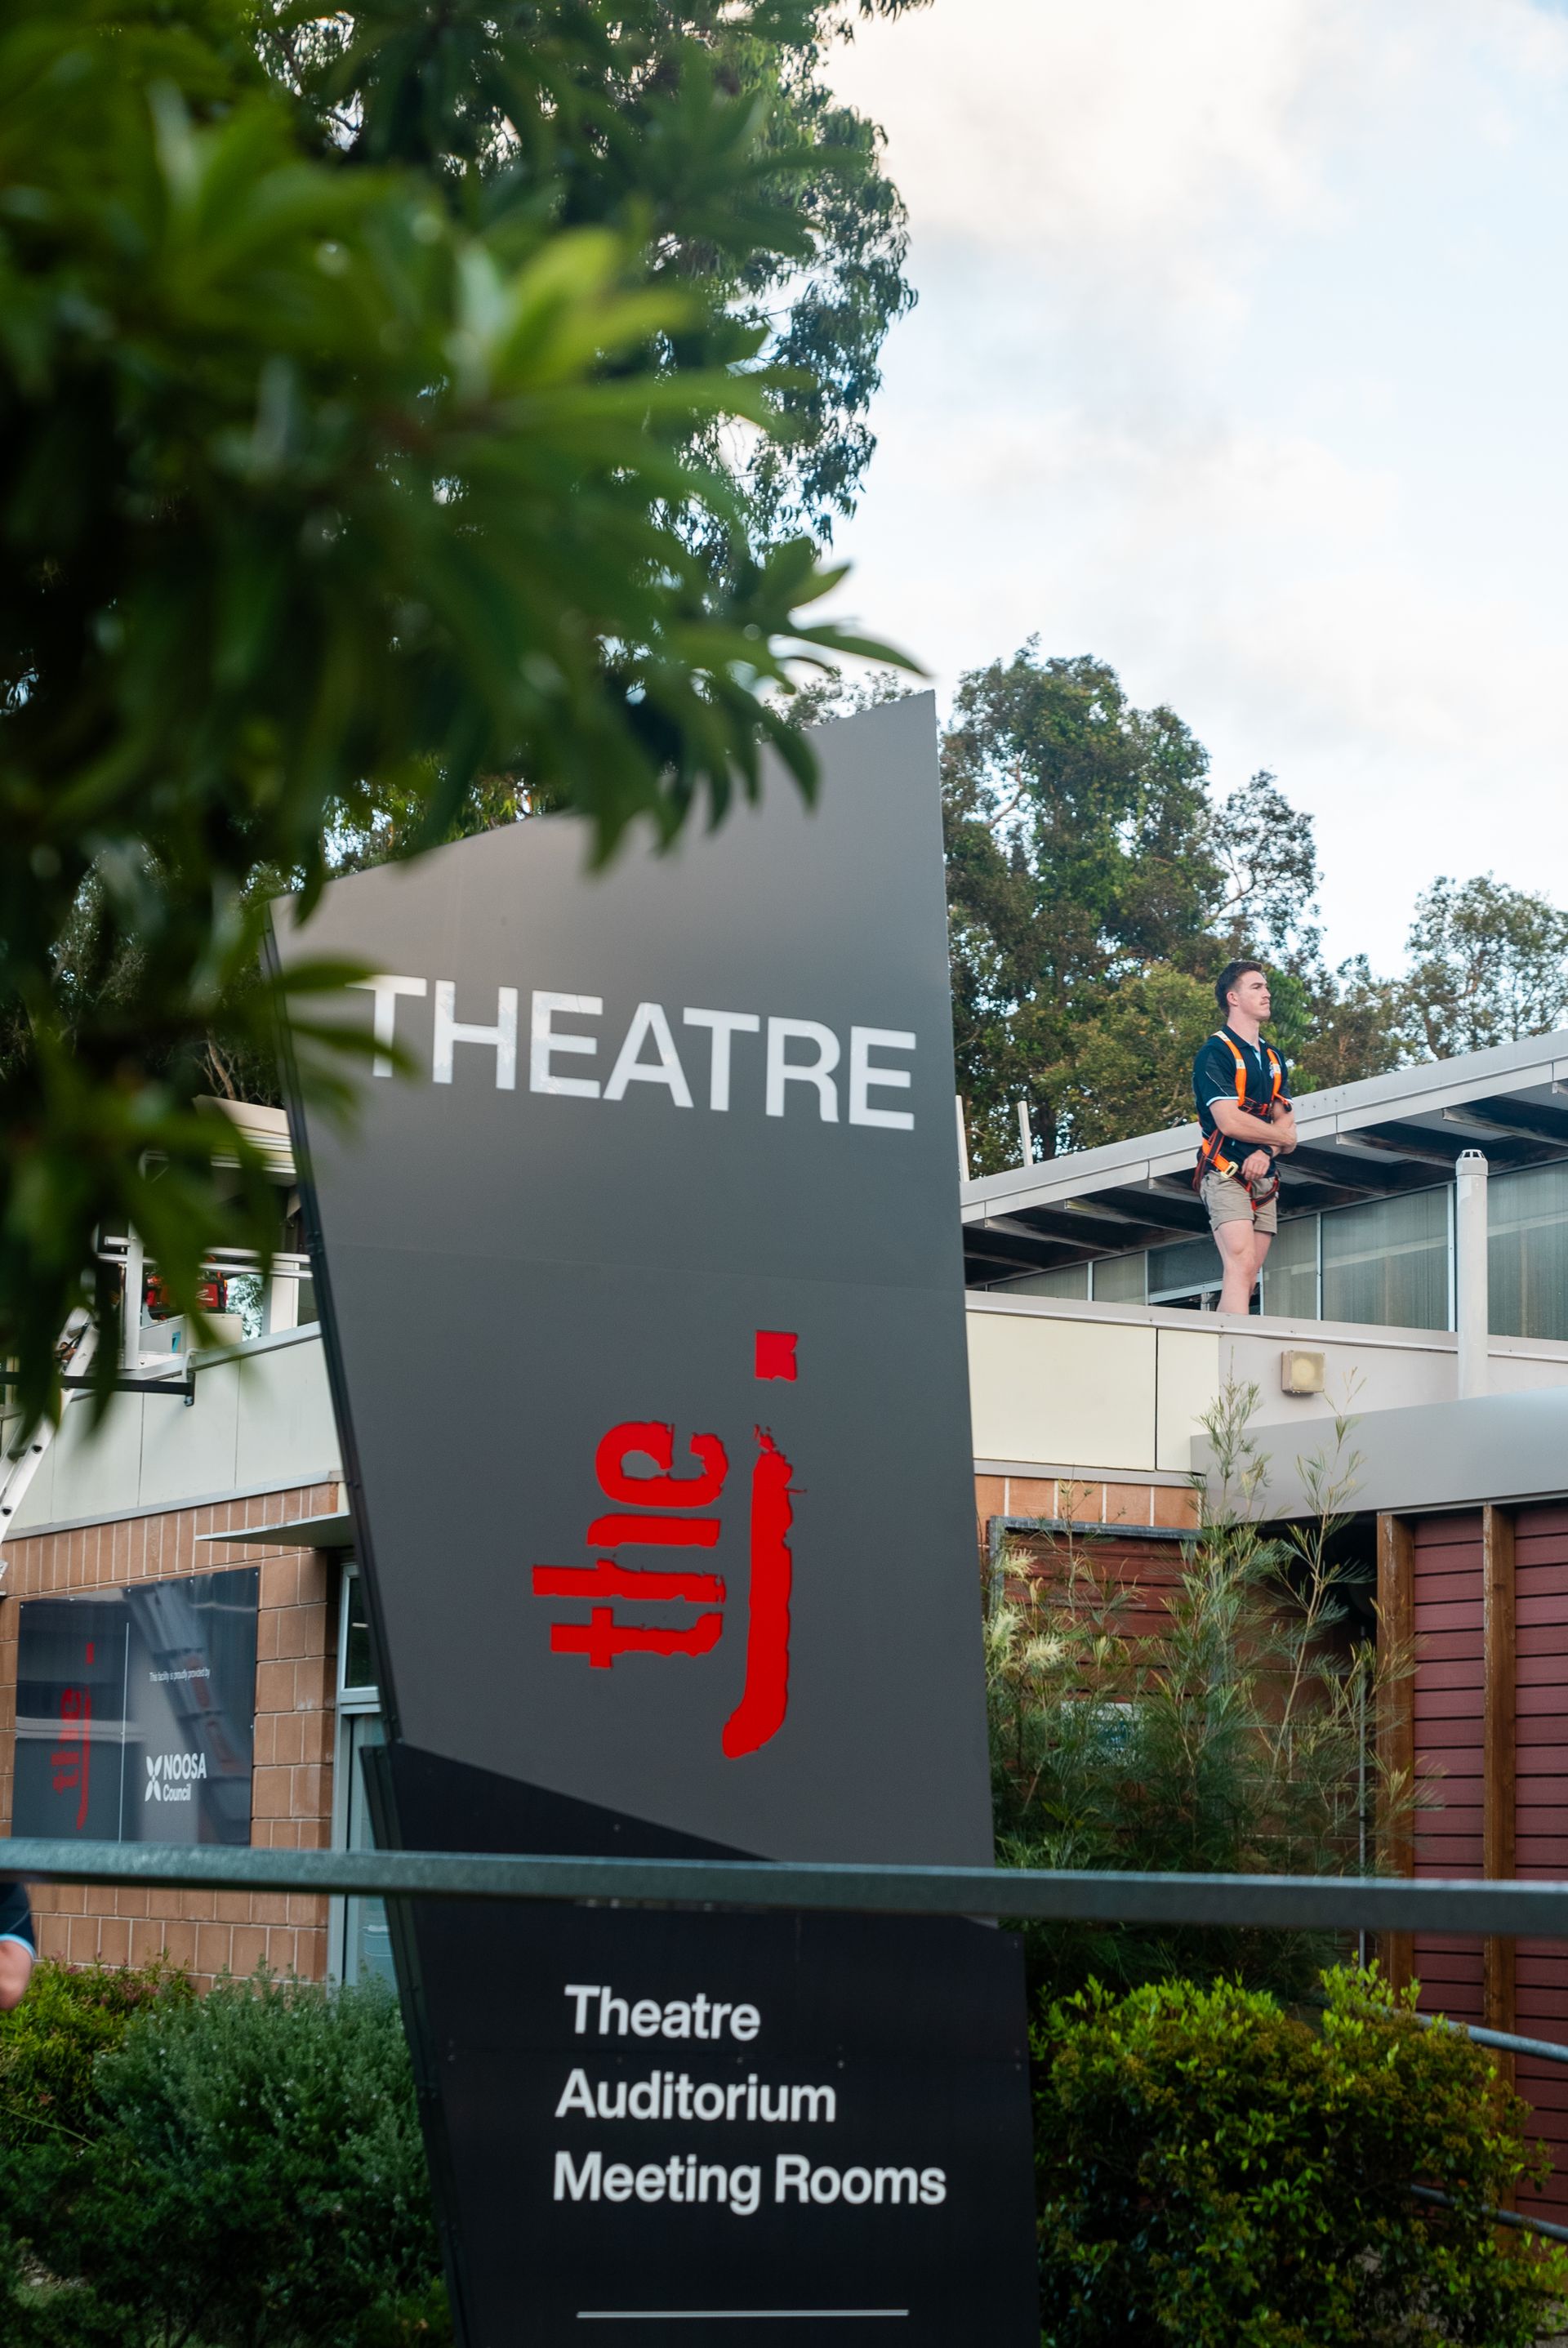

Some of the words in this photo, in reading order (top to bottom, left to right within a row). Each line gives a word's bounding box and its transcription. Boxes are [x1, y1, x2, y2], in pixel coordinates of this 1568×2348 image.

[344, 974, 916, 1130] THEATRE
[163, 1753, 207, 1780] NOOSA
[163, 1783, 191, 1802] Council
[564, 1985, 760, 2042] Theatre
[555, 2069, 835, 2123] Auditorium
[553, 2151, 760, 2216] Meeting
[775, 2154, 947, 2205] Rooms
